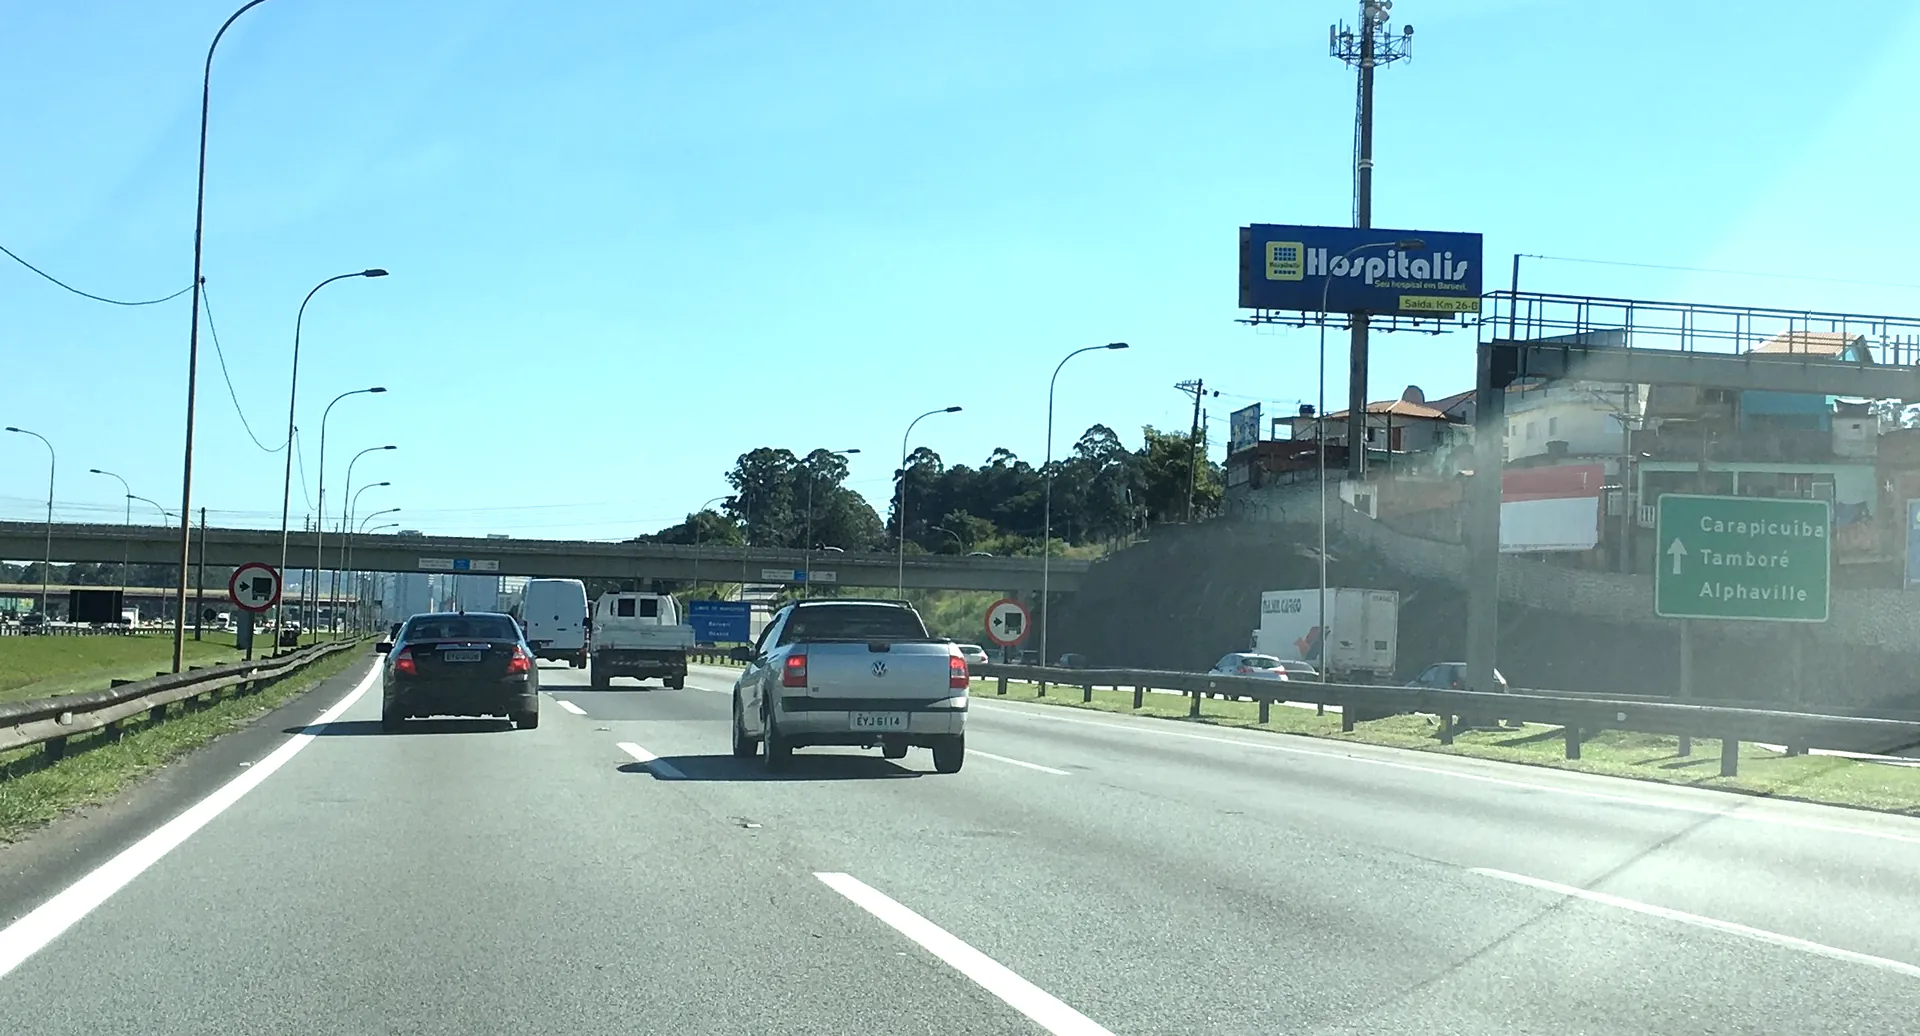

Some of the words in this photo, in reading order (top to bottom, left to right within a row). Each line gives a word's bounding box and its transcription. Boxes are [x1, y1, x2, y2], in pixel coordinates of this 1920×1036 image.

[1307, 247, 1468, 285] Hospitalis
[1391, 279, 1422, 290] hospital
[1436, 299, 1454, 310] Km
[1699, 516, 1824, 538] Carapicuíba
[1699, 548, 1790, 568] Tamboré
[1699, 581, 1808, 602] Alphaville
